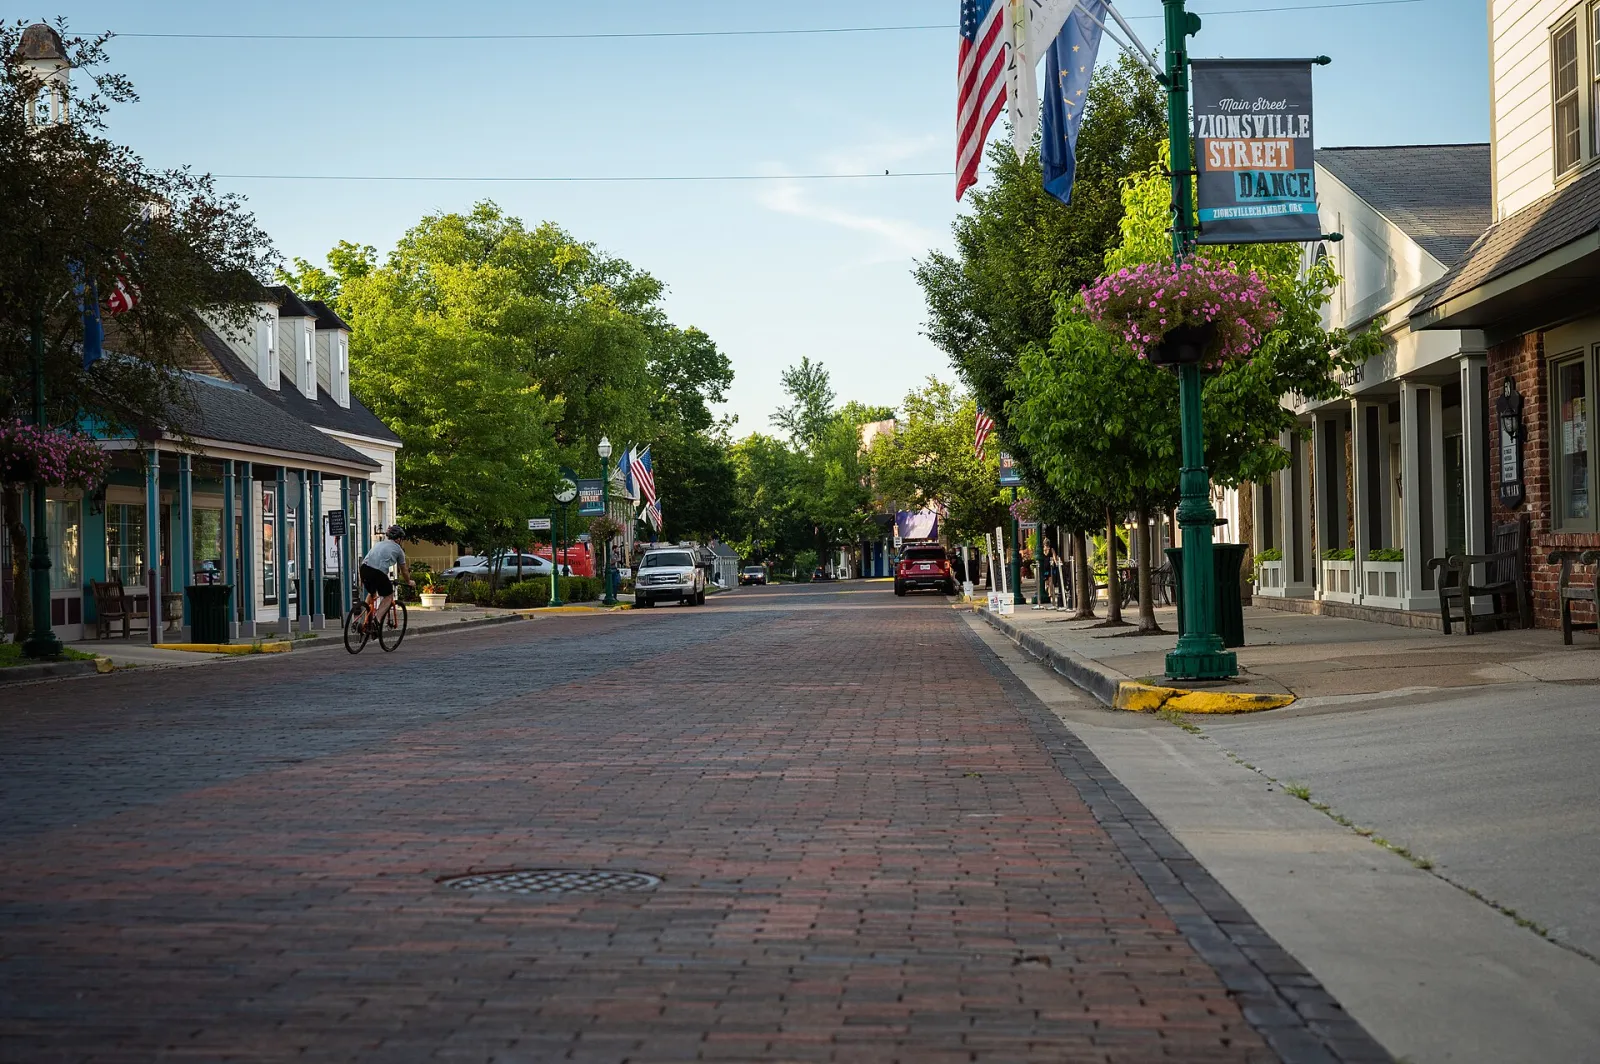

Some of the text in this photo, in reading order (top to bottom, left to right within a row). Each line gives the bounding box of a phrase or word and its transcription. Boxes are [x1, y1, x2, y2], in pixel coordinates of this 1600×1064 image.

[1219, 97, 1287, 112] Main Street
[1198, 114, 1310, 138] ZIONSVILLE
[1209, 141, 1289, 168] STREET
[1238, 172, 1311, 198] DANCE
[1213, 203, 1303, 219] ZIONSVILLECHAMBER.ORG
